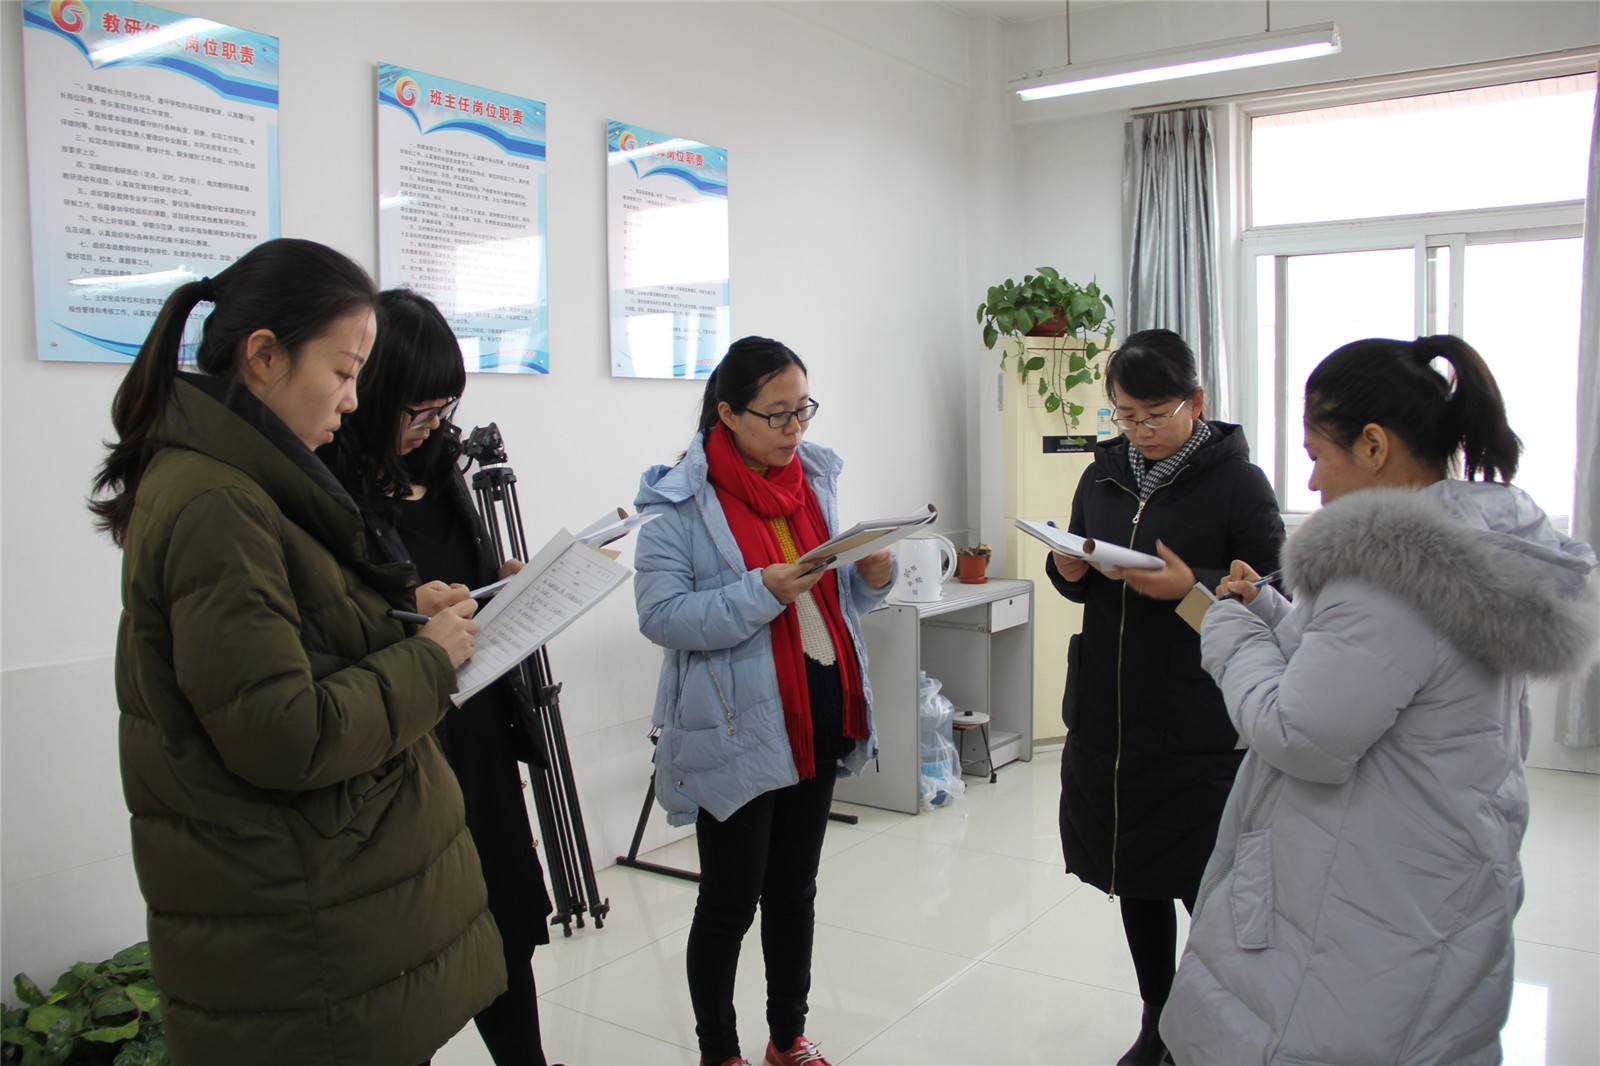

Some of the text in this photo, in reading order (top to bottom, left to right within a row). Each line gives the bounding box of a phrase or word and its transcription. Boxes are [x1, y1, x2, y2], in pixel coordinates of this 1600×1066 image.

[429, 89, 524, 125] 班主任岗位职责
